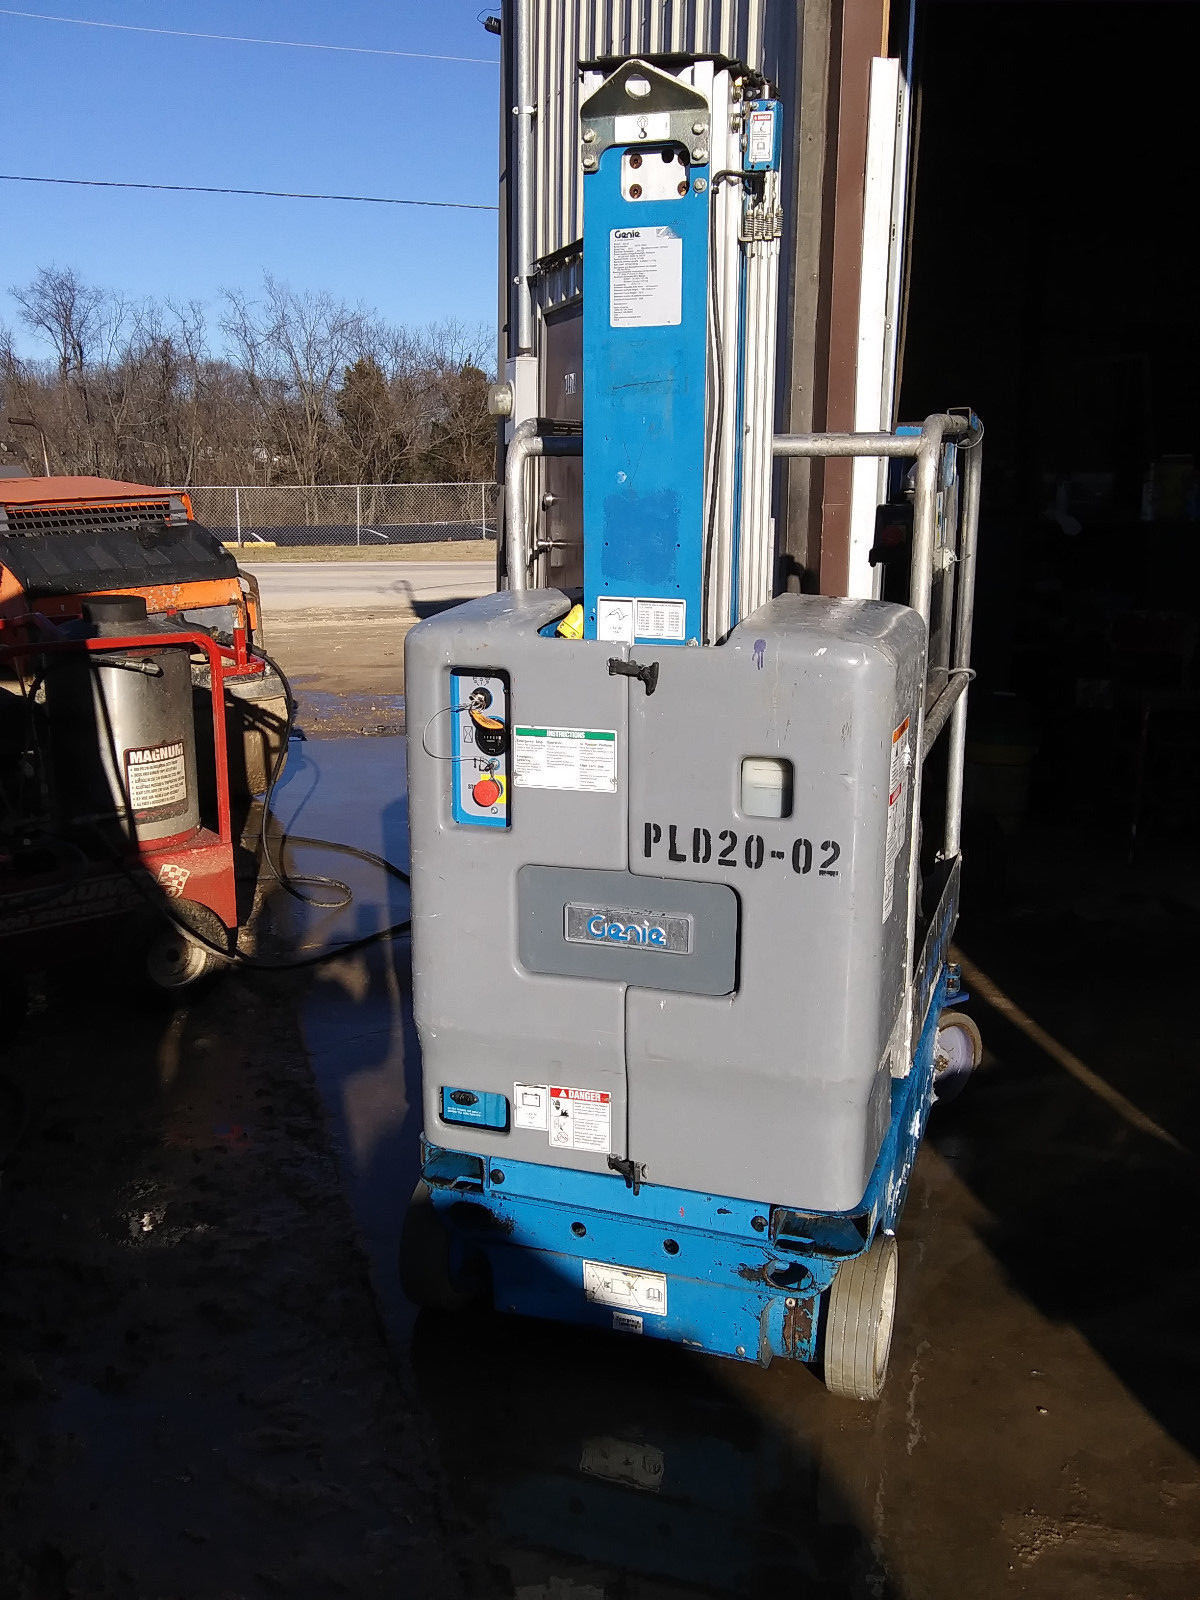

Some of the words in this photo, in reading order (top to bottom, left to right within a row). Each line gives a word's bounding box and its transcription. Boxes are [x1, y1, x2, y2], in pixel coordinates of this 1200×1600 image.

[614, 230, 641, 239] Genie
[129, 742, 184, 764] MAGNUM
[643, 822, 841, 877] PLD20-02
[586, 914, 667, 946] Genie
[568, 1089, 601, 1102] DANGER
